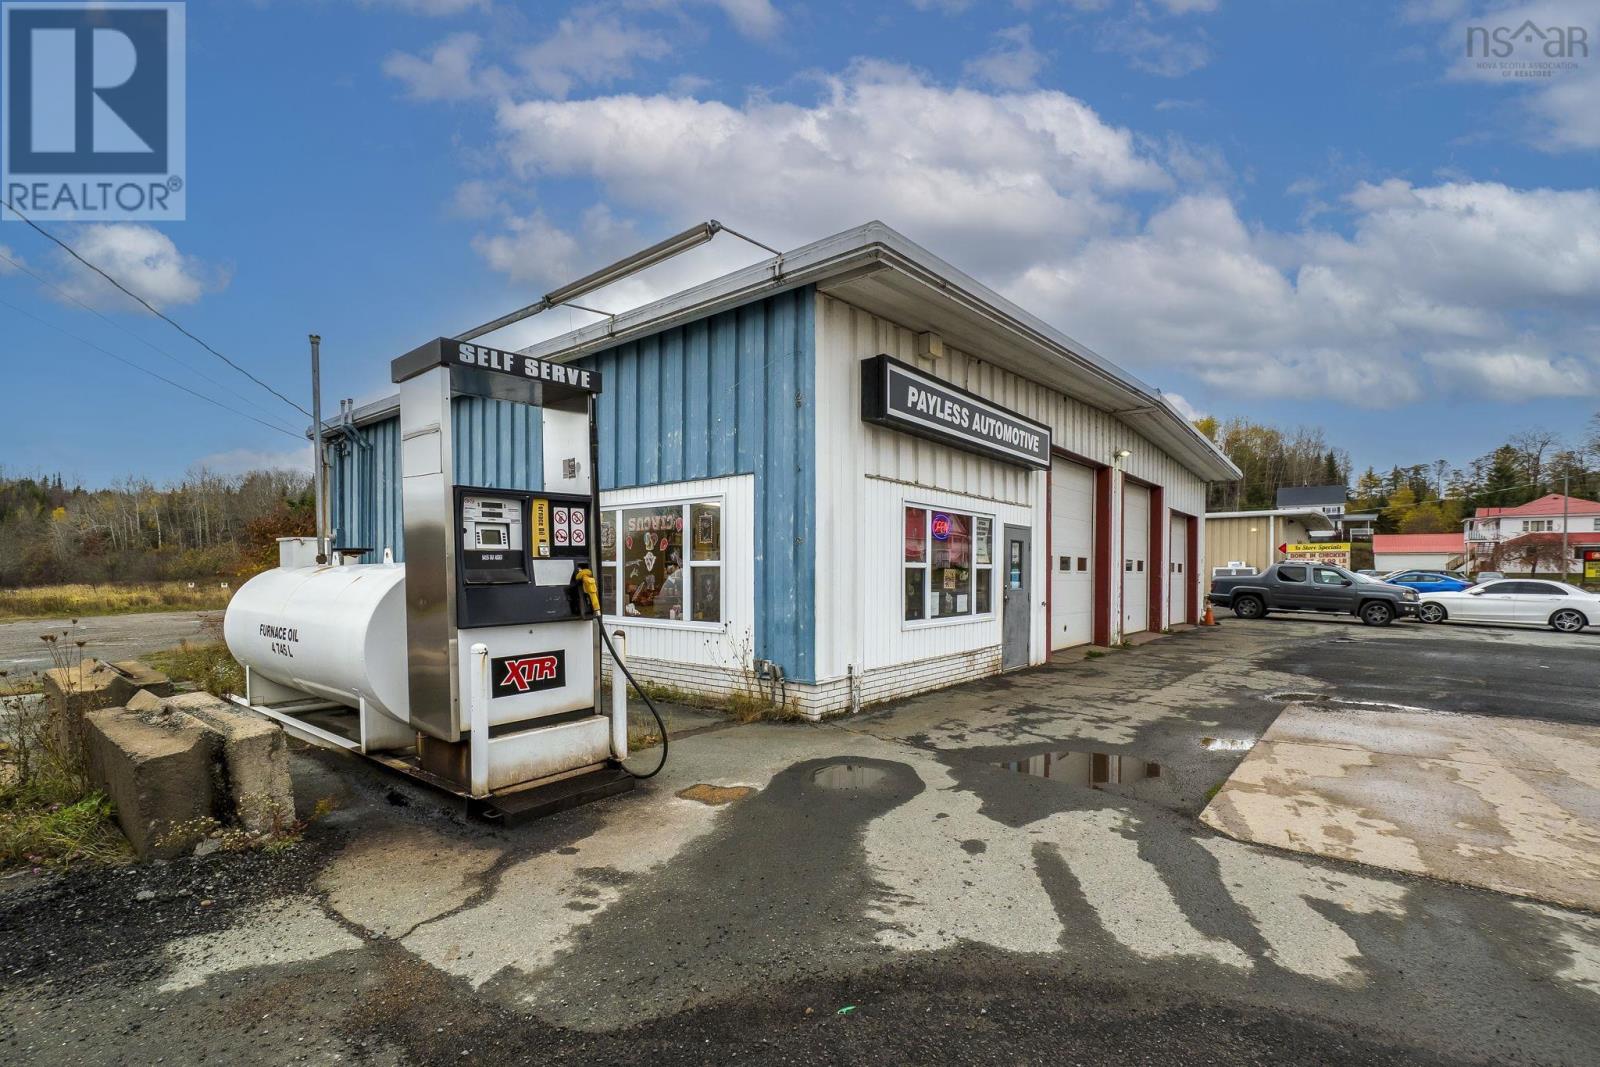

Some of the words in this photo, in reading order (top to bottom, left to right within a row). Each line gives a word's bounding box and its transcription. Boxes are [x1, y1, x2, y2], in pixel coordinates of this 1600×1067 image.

[458, 343, 514, 372] SELF
[524, 358, 591, 388] SERVE
[907, 386, 970, 428] PAYLESS
[972, 412, 1040, 453] AUTOMOTIVE
[259, 623, 287, 640] FURNACE
[288, 628, 299, 642] OIL
[500, 655, 558, 691] XTR
